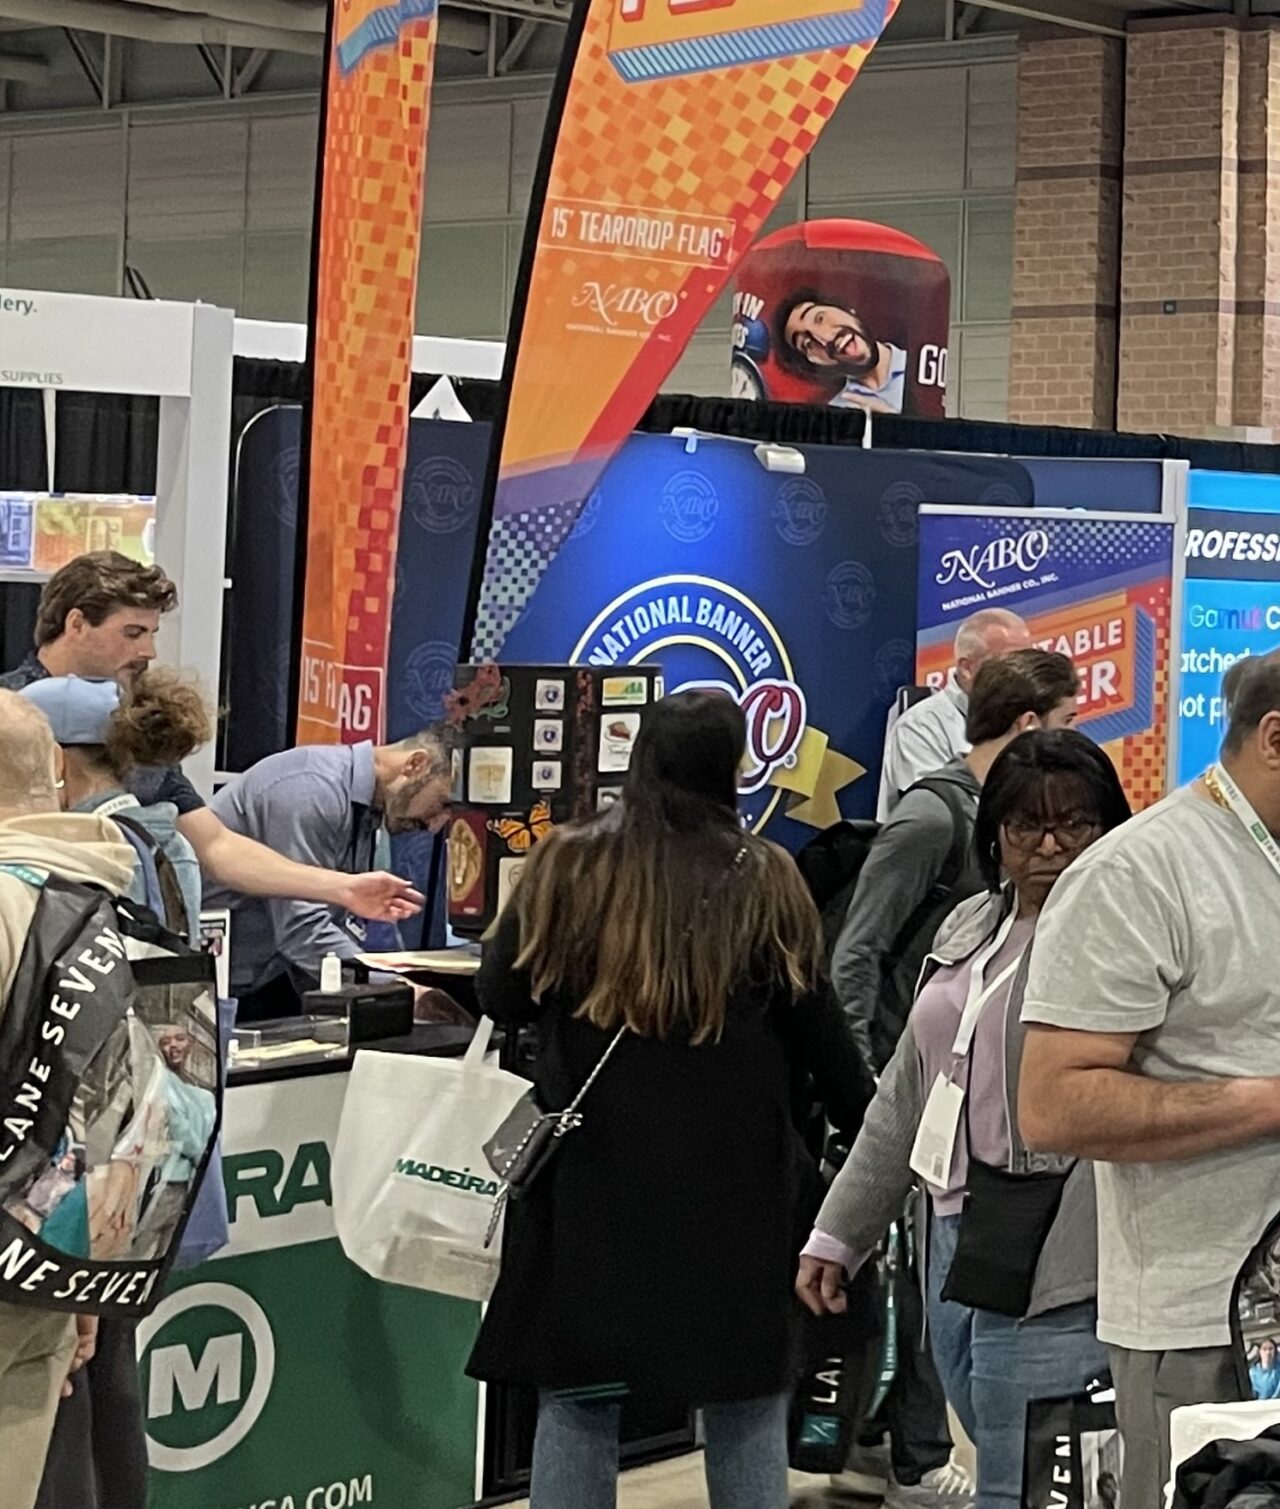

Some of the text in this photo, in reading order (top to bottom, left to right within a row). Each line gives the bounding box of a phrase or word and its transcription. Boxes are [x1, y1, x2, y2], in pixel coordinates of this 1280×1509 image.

[579, 210, 673, 250] TEARDROP
[678, 223, 724, 257] FLAG
[1, 370, 64, 385] SUPPLIES
[588, 595, 772, 677] NATIONAL BANNER
[1188, 604, 1263, 630] Gamut
[41, 927, 126, 1046] SEVEN
[147, 1332, 244, 1420] M
